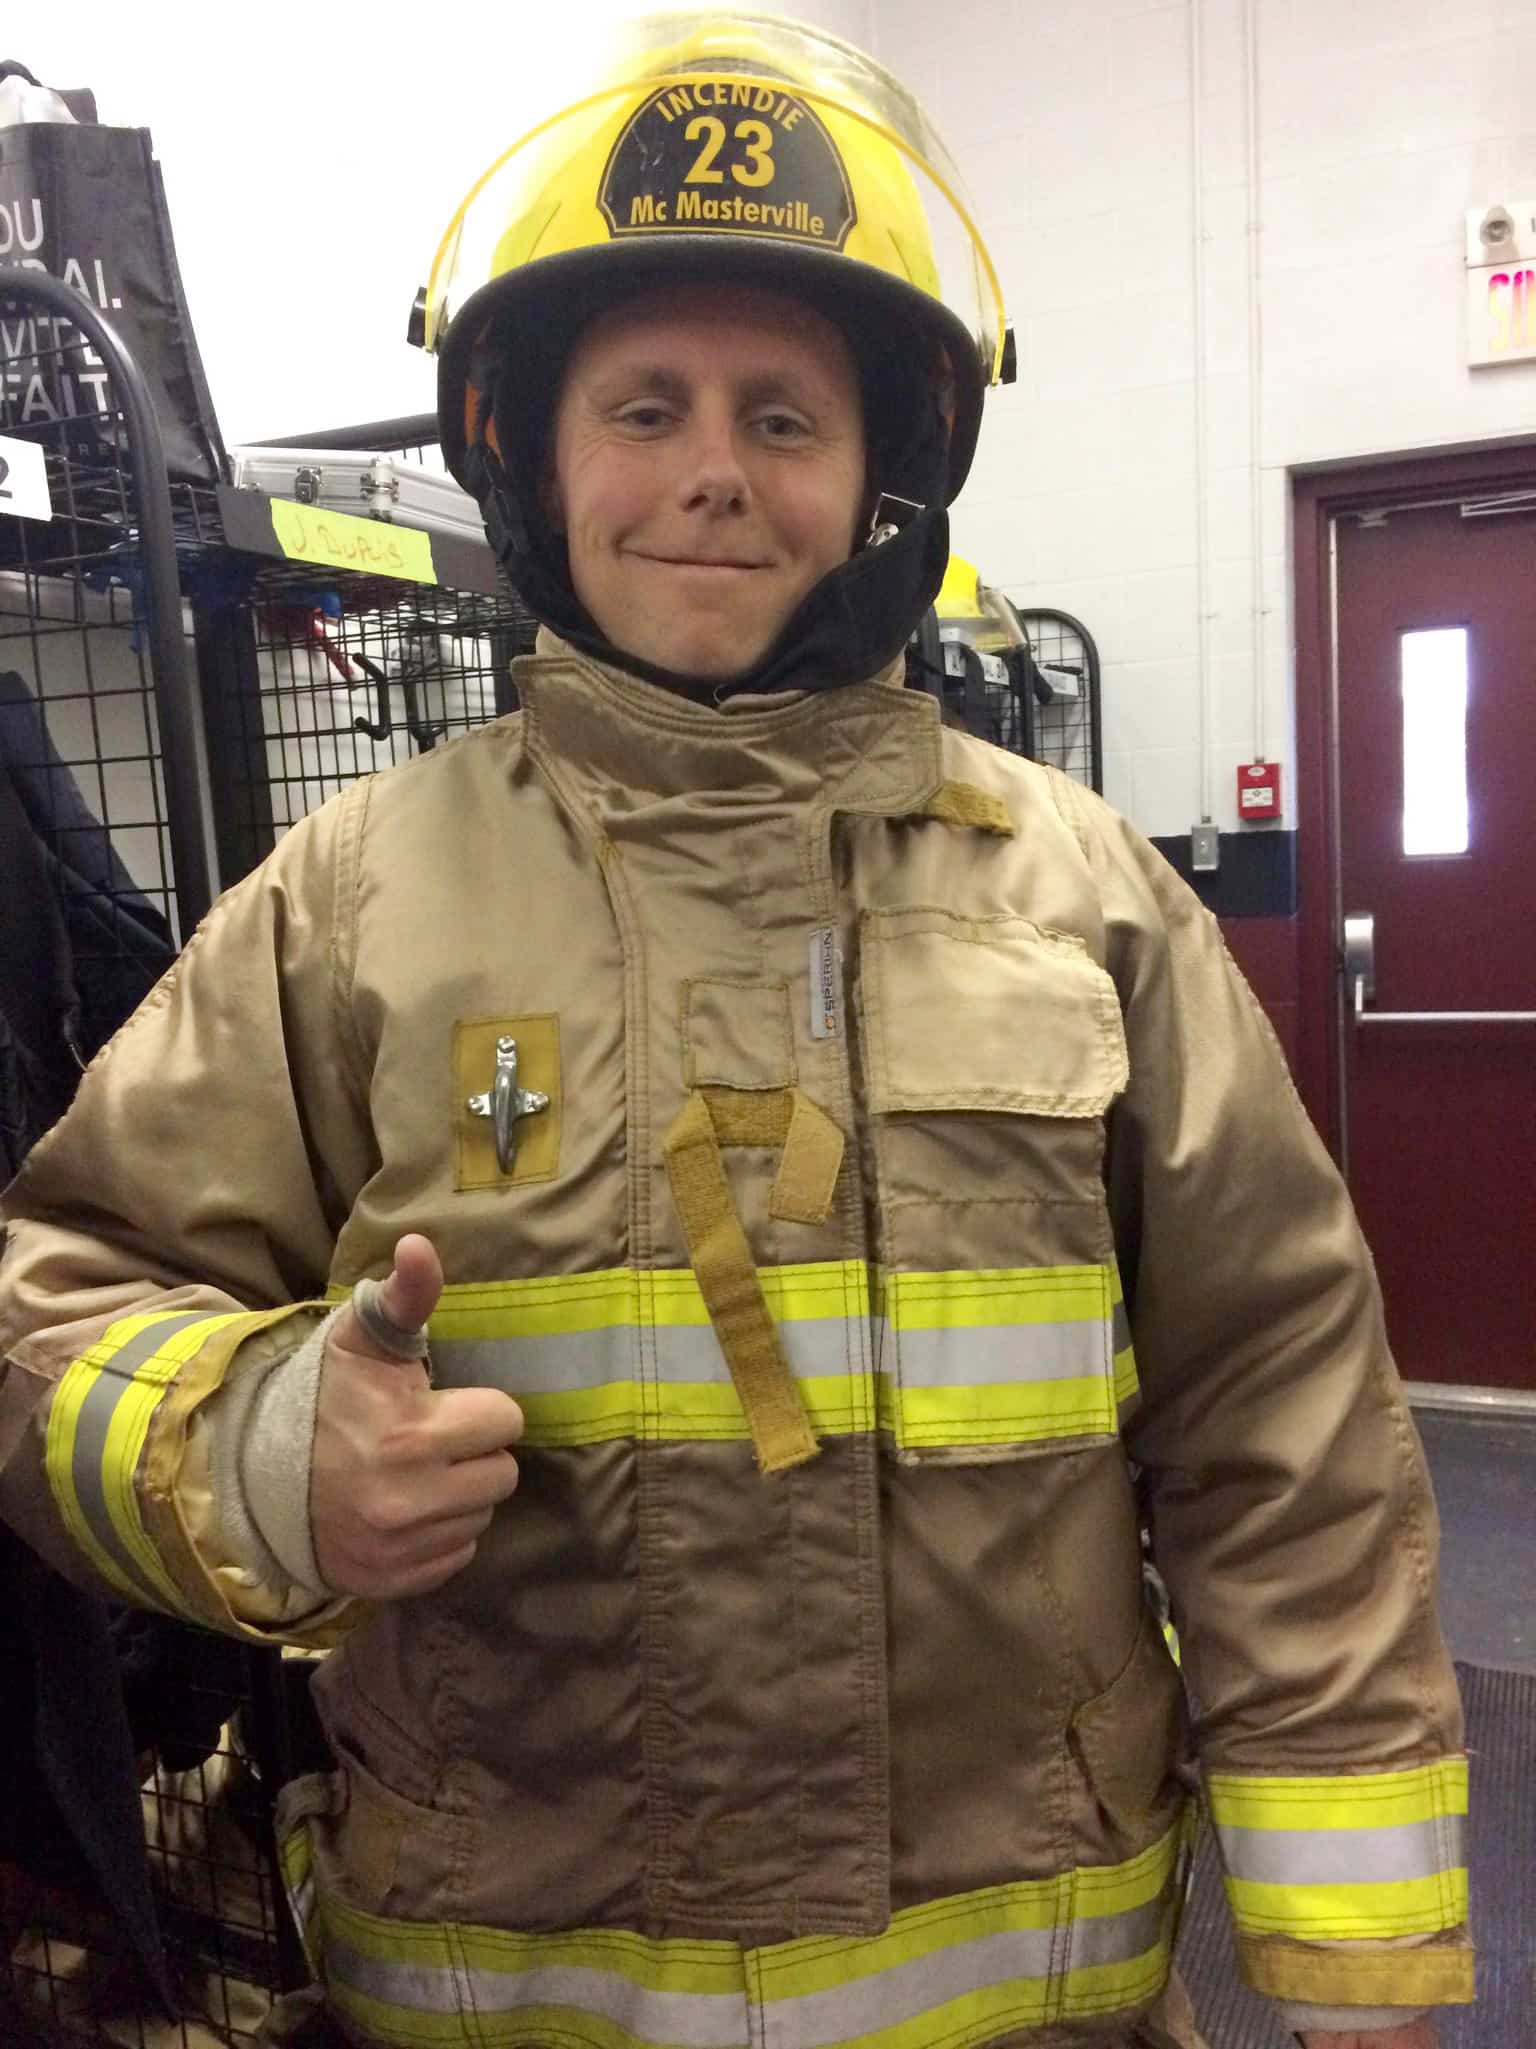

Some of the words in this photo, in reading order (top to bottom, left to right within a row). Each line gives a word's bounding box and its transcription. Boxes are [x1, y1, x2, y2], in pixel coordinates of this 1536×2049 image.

[656, 83, 805, 131] INCENDIE
[683, 116, 775, 187] 23
[630, 195, 667, 225] Mc
[675, 191, 824, 236] Masterville
